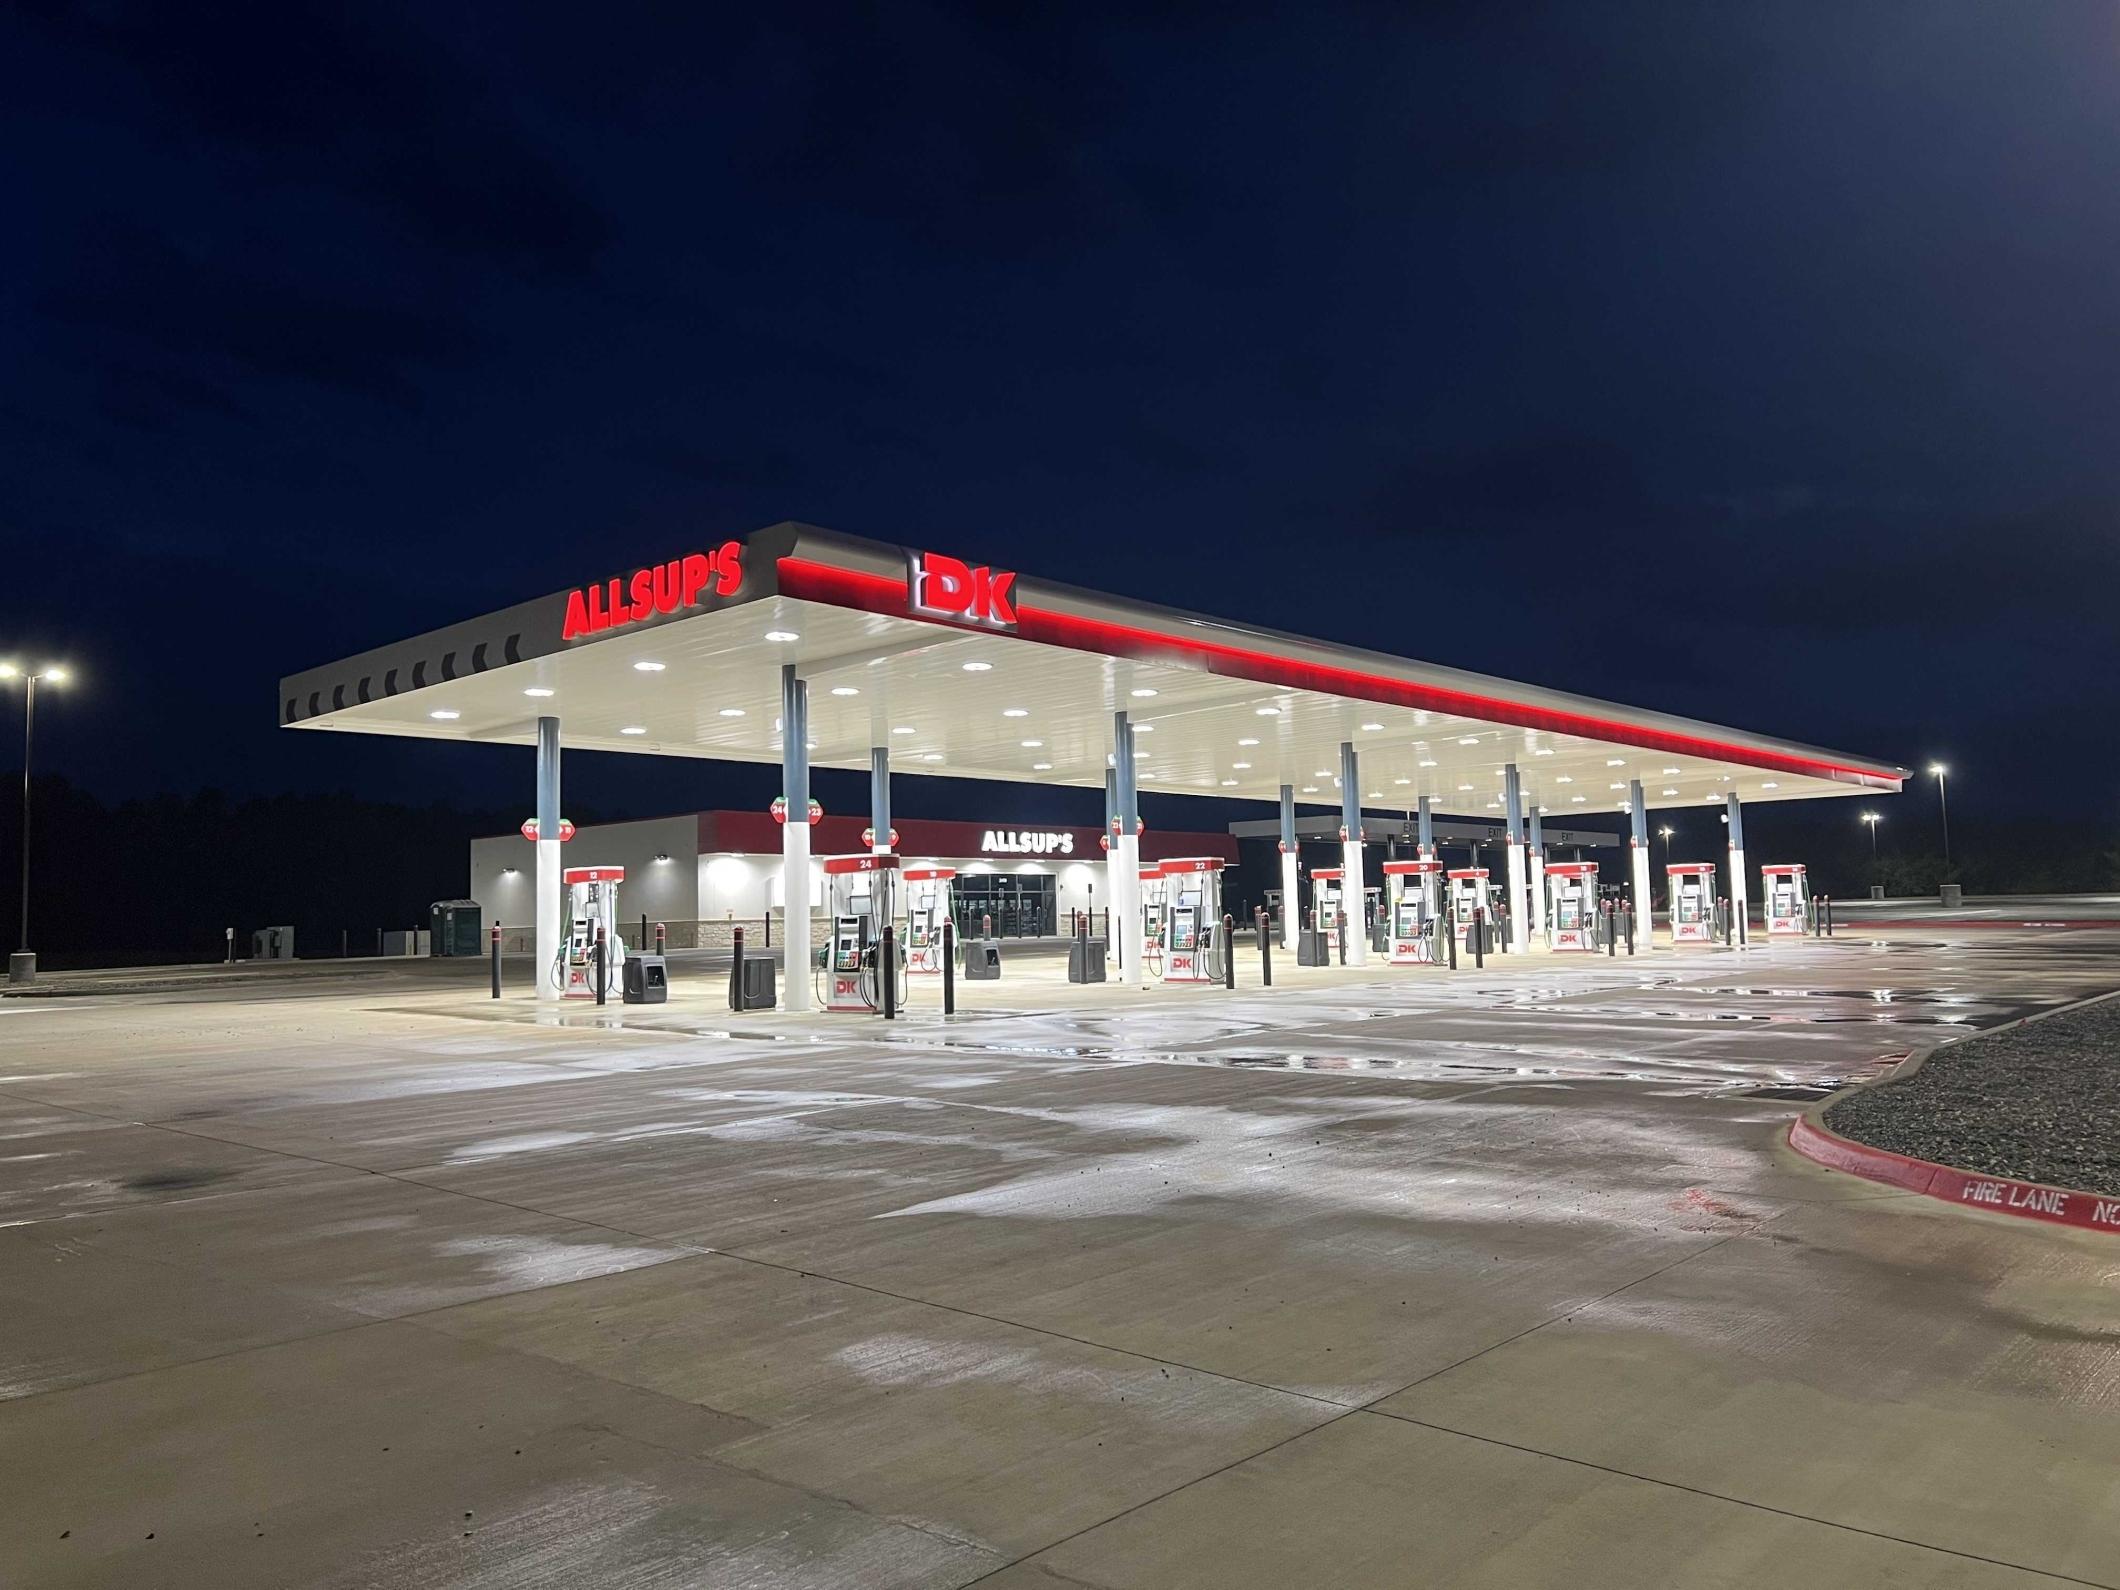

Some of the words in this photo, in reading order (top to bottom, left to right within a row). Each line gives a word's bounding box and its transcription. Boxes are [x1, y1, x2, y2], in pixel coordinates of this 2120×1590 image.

[563, 541, 743, 640] ALLSUP'S
[923, 552, 1018, 624] DK
[1488, 827, 1502, 838] EXIT
[1561, 832, 1574, 842] EXIT
[982, 831, 1073, 854] ALLSUP'S
[860, 860, 872, 869] 24
[1560, 934, 1577, 943] DK
[1398, 944, 1417, 953] DK
[1173, 957, 1192, 969] DK
[571, 972, 585, 984] DK
[836, 981, 857, 993] DK
[1962, 1180, 2007, 1203] FIRE
[2009, 1186, 2069, 1215] LANE
